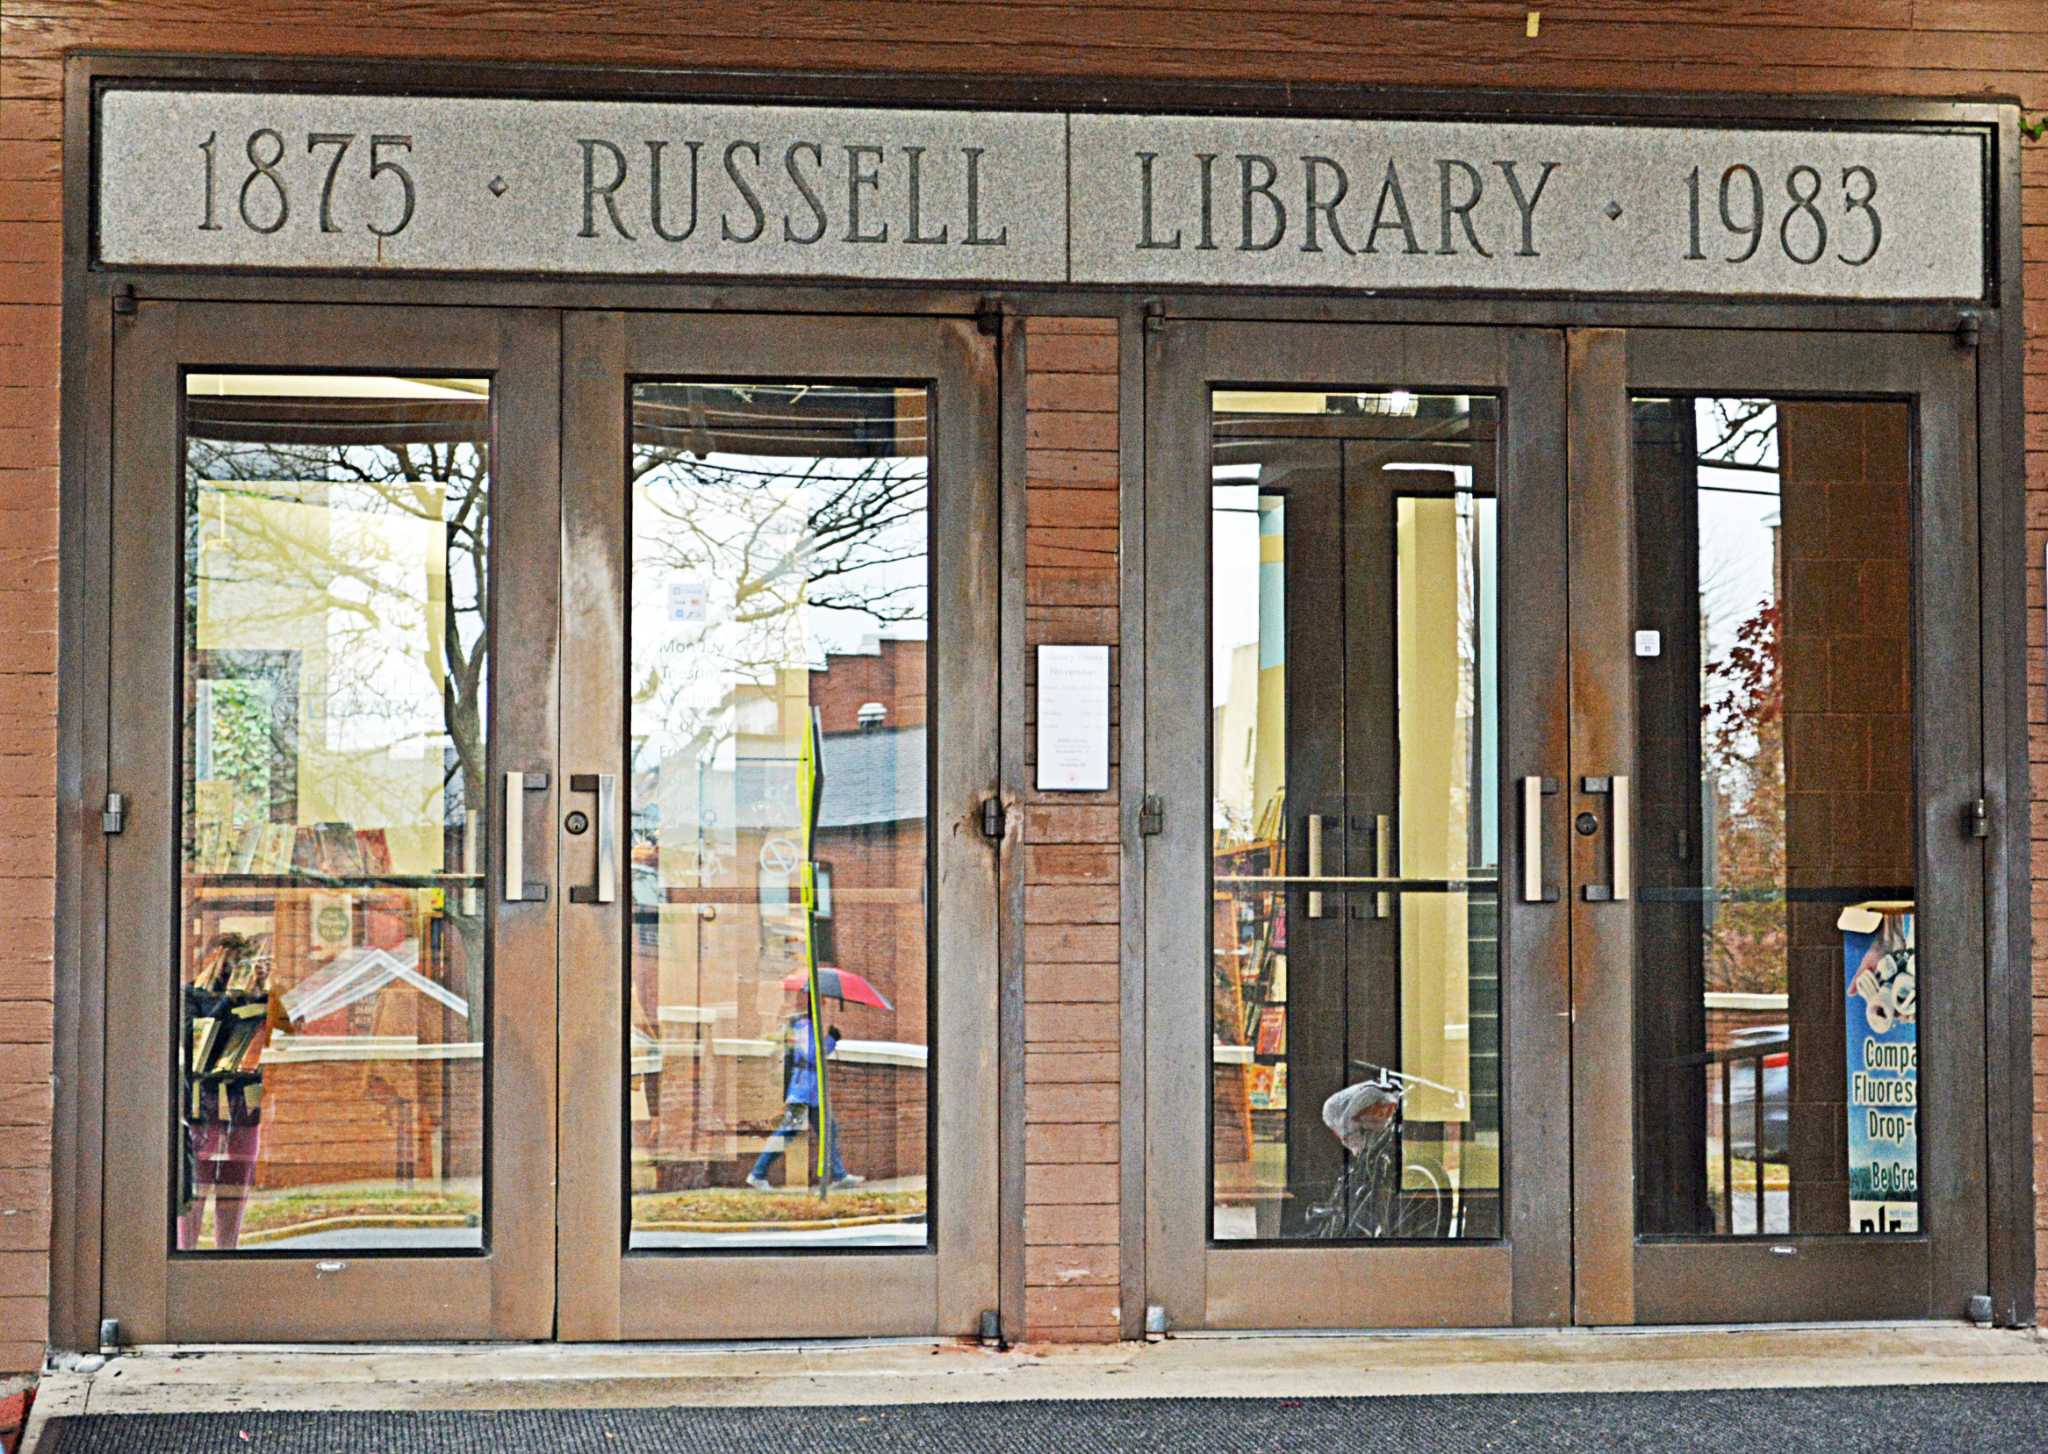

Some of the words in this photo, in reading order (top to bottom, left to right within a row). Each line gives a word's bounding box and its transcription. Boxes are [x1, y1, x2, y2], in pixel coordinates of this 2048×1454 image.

[199, 128, 417, 238] 1875
[576, 138, 1009, 247] RUSSELL
[1134, 151, 1562, 259] LIBRARY
[1682, 162, 1884, 267] 1983
[1855, 1075, 1917, 1102] Fluores
[1869, 1110, 1917, 1143] Drop-
[1872, 1161, 1888, 1189] Be
[1893, 1161, 1915, 1190] Gre
